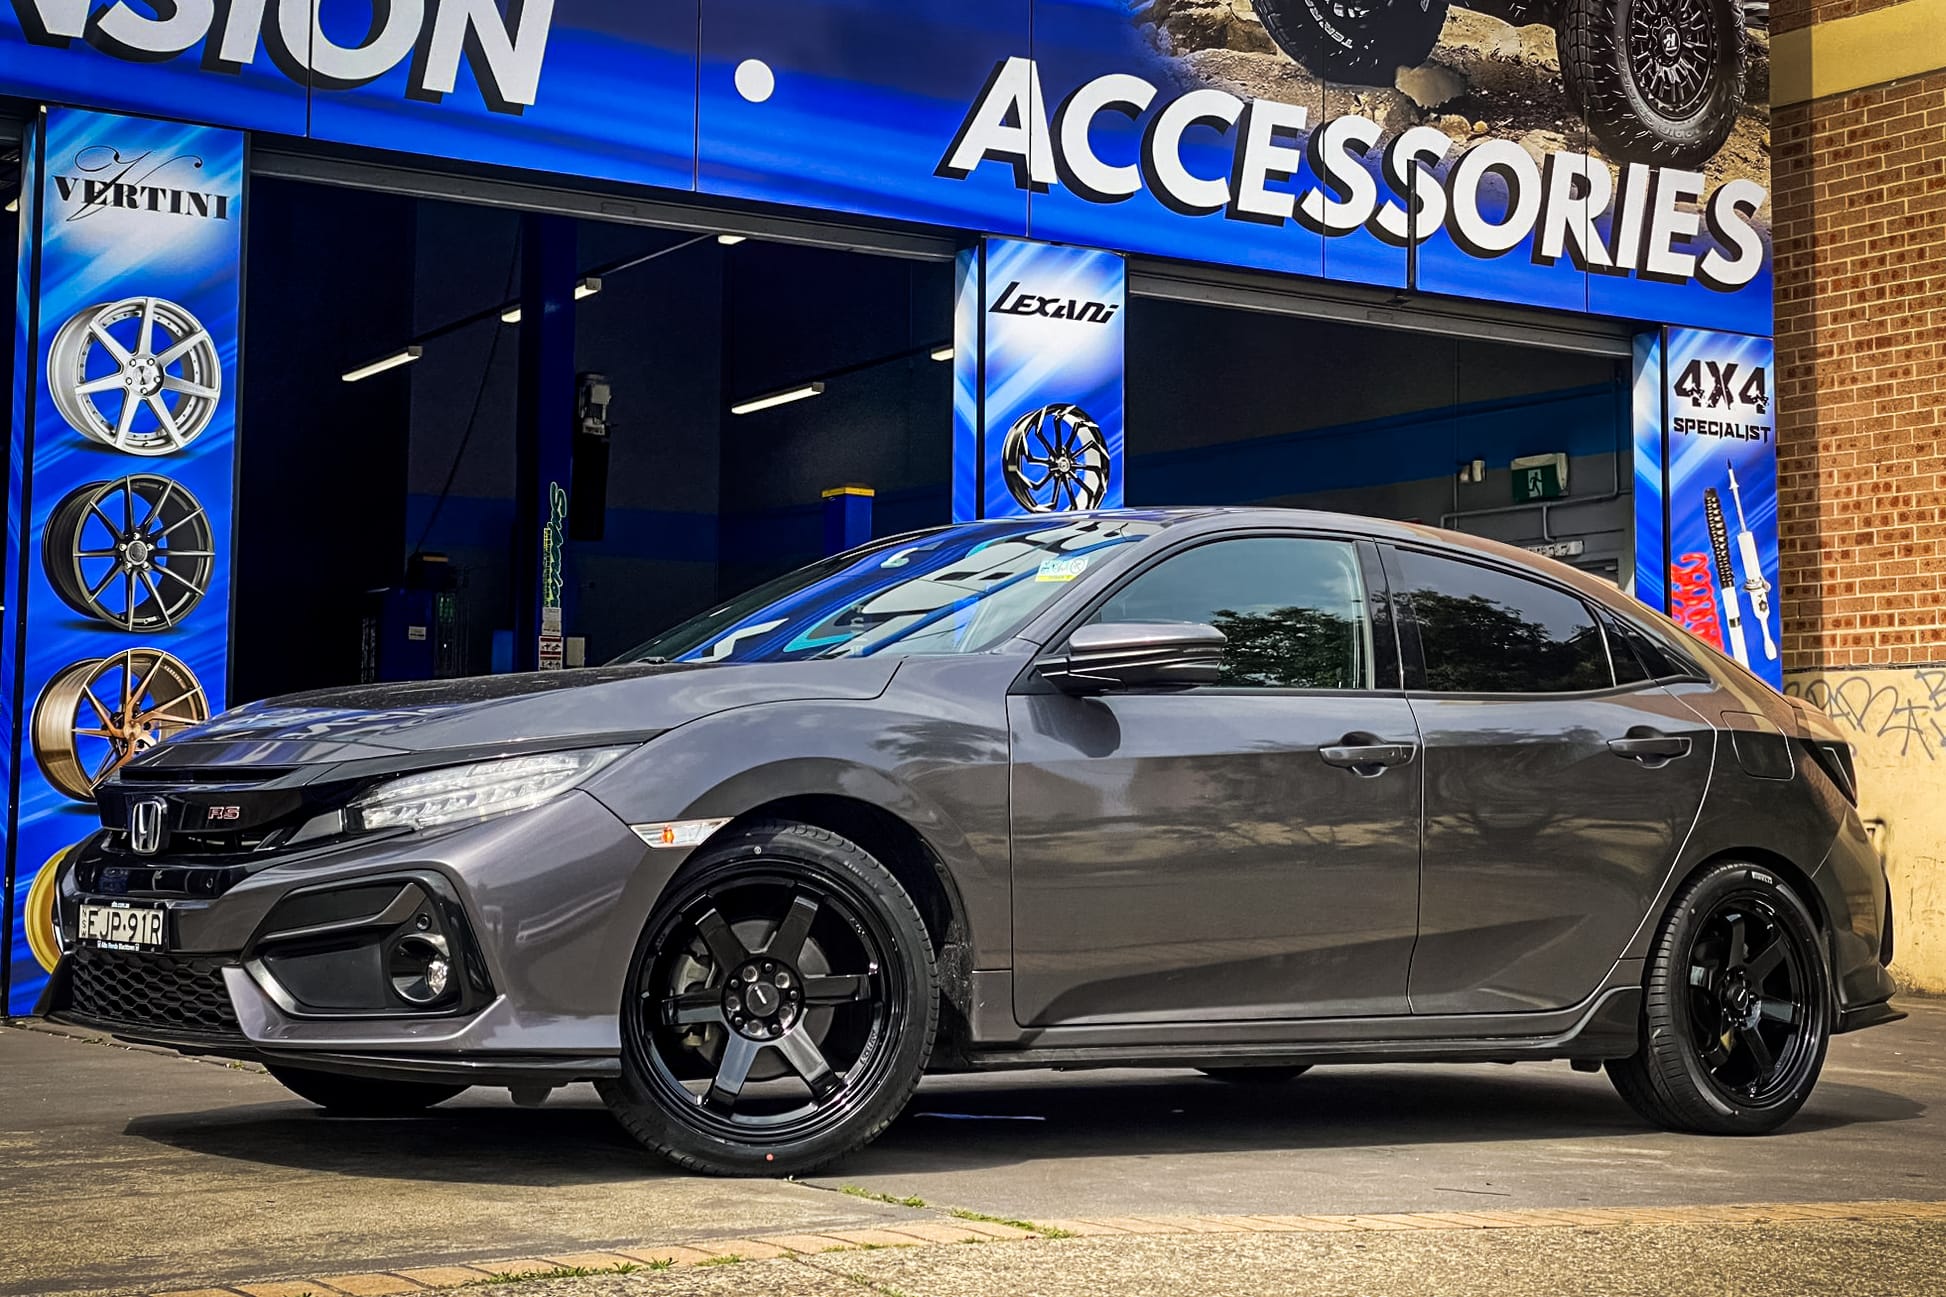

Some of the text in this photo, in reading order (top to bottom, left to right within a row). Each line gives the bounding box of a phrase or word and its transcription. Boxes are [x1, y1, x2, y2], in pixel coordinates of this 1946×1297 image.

[34, 0, 554, 106] ION
[948, 56, 1768, 286] ACCESSORIES
[54, 175, 230, 221] VERTINI
[1673, 359, 1770, 415] 4X4
[1673, 417, 1771, 444] SPECIALIST
[208, 806, 240, 820] RS
